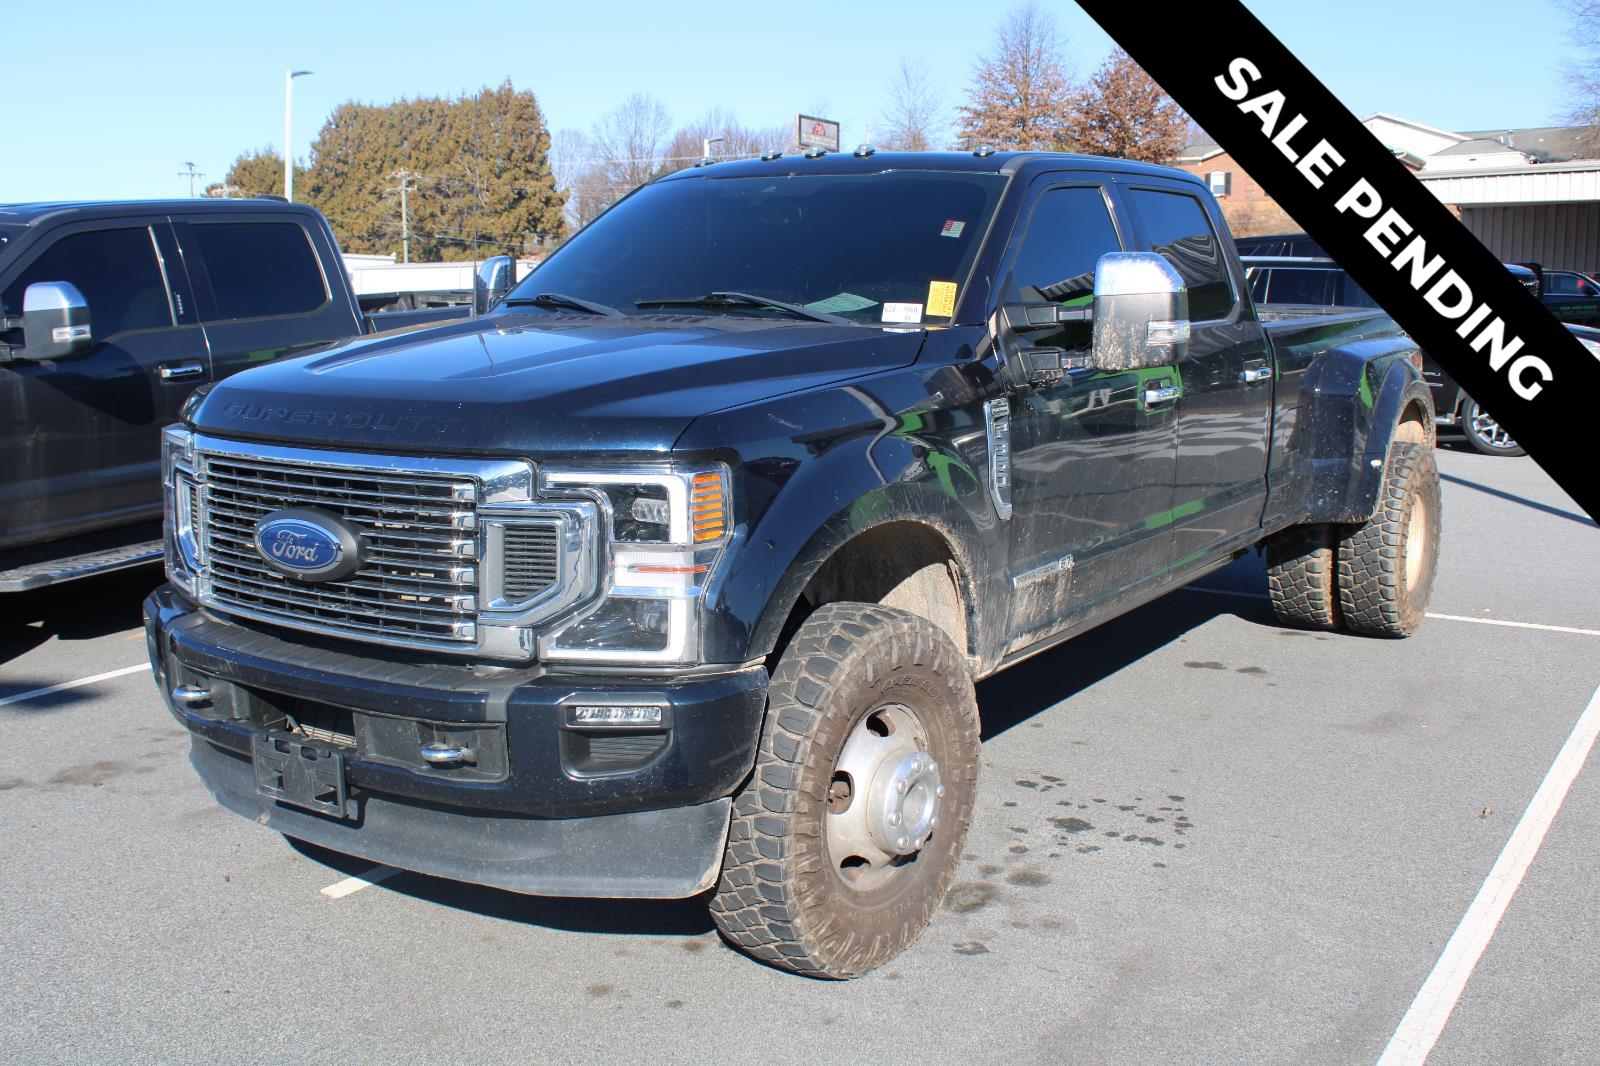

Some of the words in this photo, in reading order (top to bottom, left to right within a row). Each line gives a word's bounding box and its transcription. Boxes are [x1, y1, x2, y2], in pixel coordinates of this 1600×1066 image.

[220, 402, 338, 426] SUPER
[344, 412, 463, 434] DUTY
[272, 529, 320, 562] Ford
